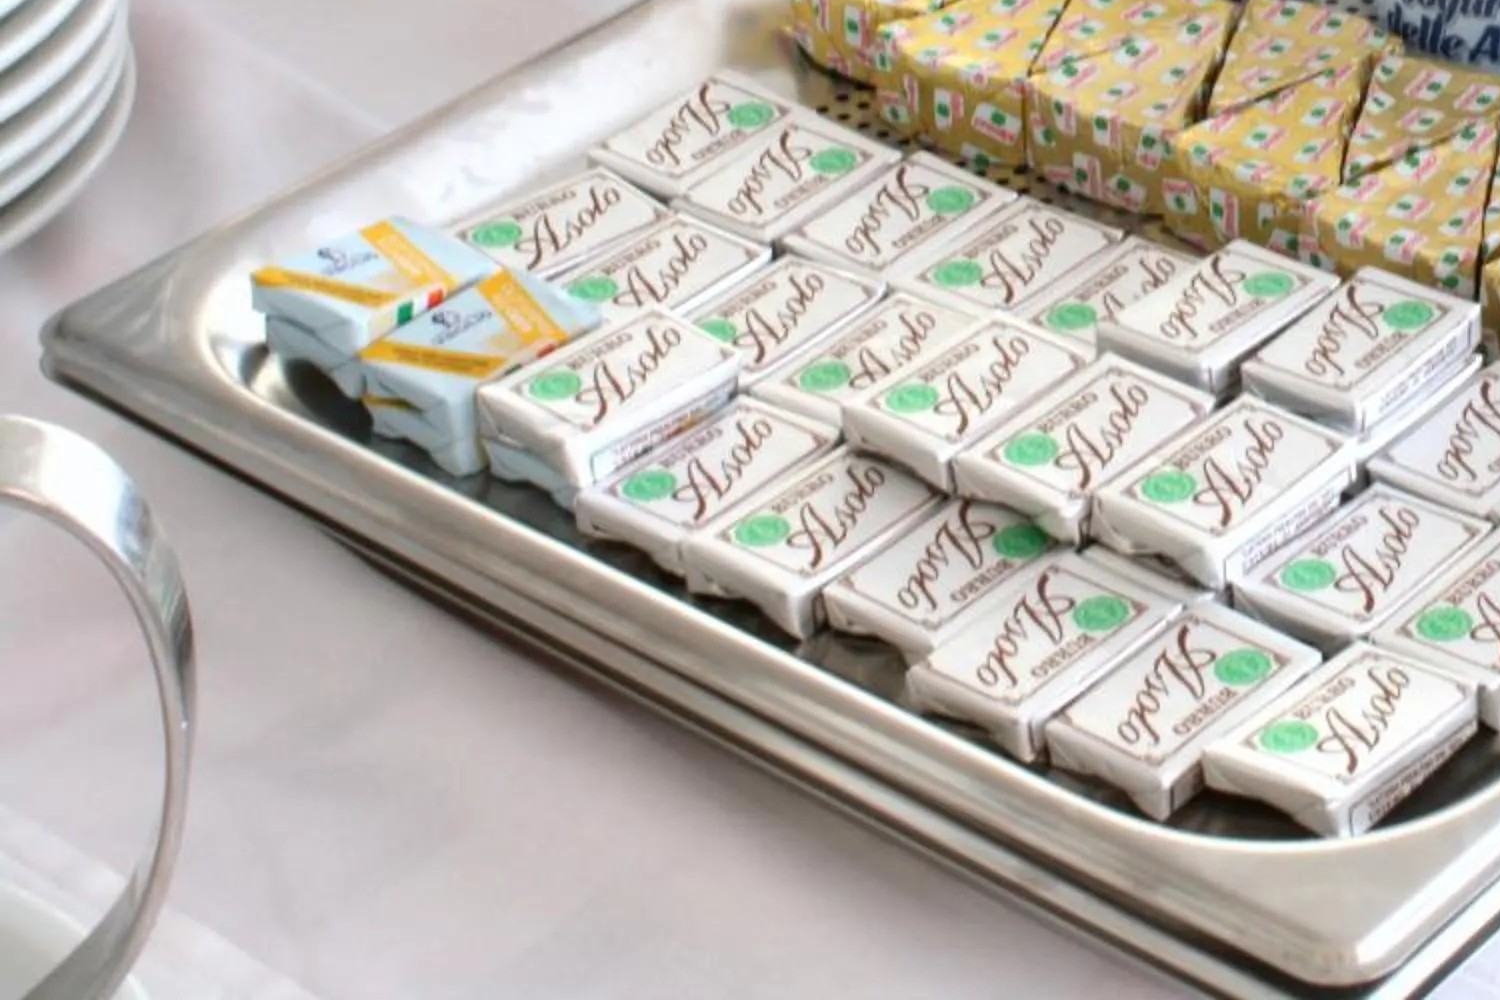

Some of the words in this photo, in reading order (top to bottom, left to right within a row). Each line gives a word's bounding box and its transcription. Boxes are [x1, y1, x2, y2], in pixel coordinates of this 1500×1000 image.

[646, 78, 732, 165] Asolo
[728, 128, 811, 218] Asolo
[847, 167, 929, 254] Asolo
[515, 186, 621, 268] Asolo
[614, 232, 708, 307] Asolo
[981, 213, 1065, 303] Asolo
[733, 273, 825, 364] Asolo
[1160, 251, 1246, 339] Asolo
[1306, 286, 1384, 376] Asolo
[576, 325, 682, 424] Asolo
[936, 333, 1030, 435] Asolo
[673, 419, 773, 520] Asolo
[1055, 380, 1149, 488] Asolo
[1194, 420, 1284, 526] Asolo
[787, 466, 885, 568] Asolo
[898, 502, 995, 611] Asolo
[1335, 507, 1420, 611] Asolo
[977, 574, 1075, 687] Asolo
[1118, 626, 1217, 746] Asolo
[1318, 667, 1409, 774] Asolo
